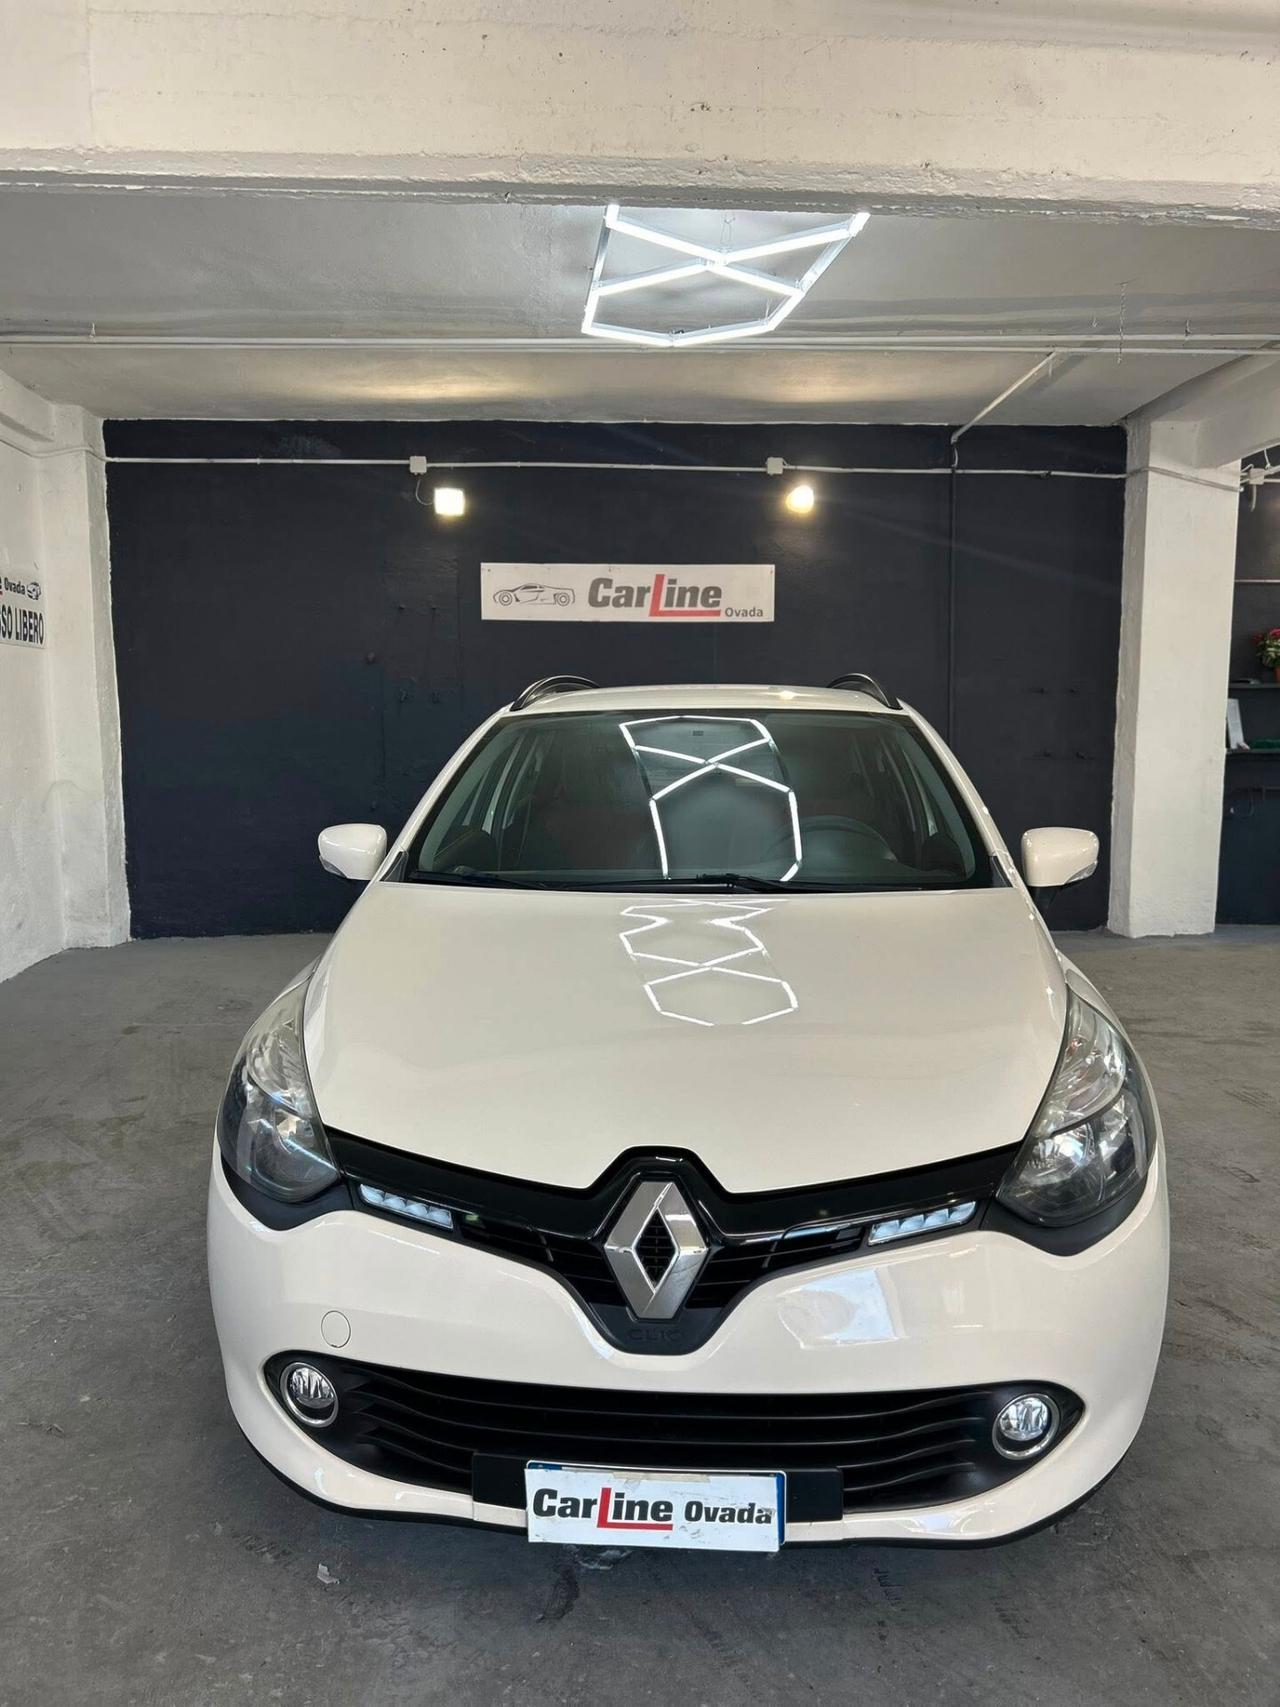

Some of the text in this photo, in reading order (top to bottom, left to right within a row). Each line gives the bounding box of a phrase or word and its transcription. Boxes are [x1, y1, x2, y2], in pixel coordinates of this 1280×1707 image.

[4, 577, 26, 595] Ovada
[588, 574, 764, 618] CarLine Ovada
[0, 604, 45, 646] SO LIBERO
[533, 1487, 772, 1531] CarLine Ovada
